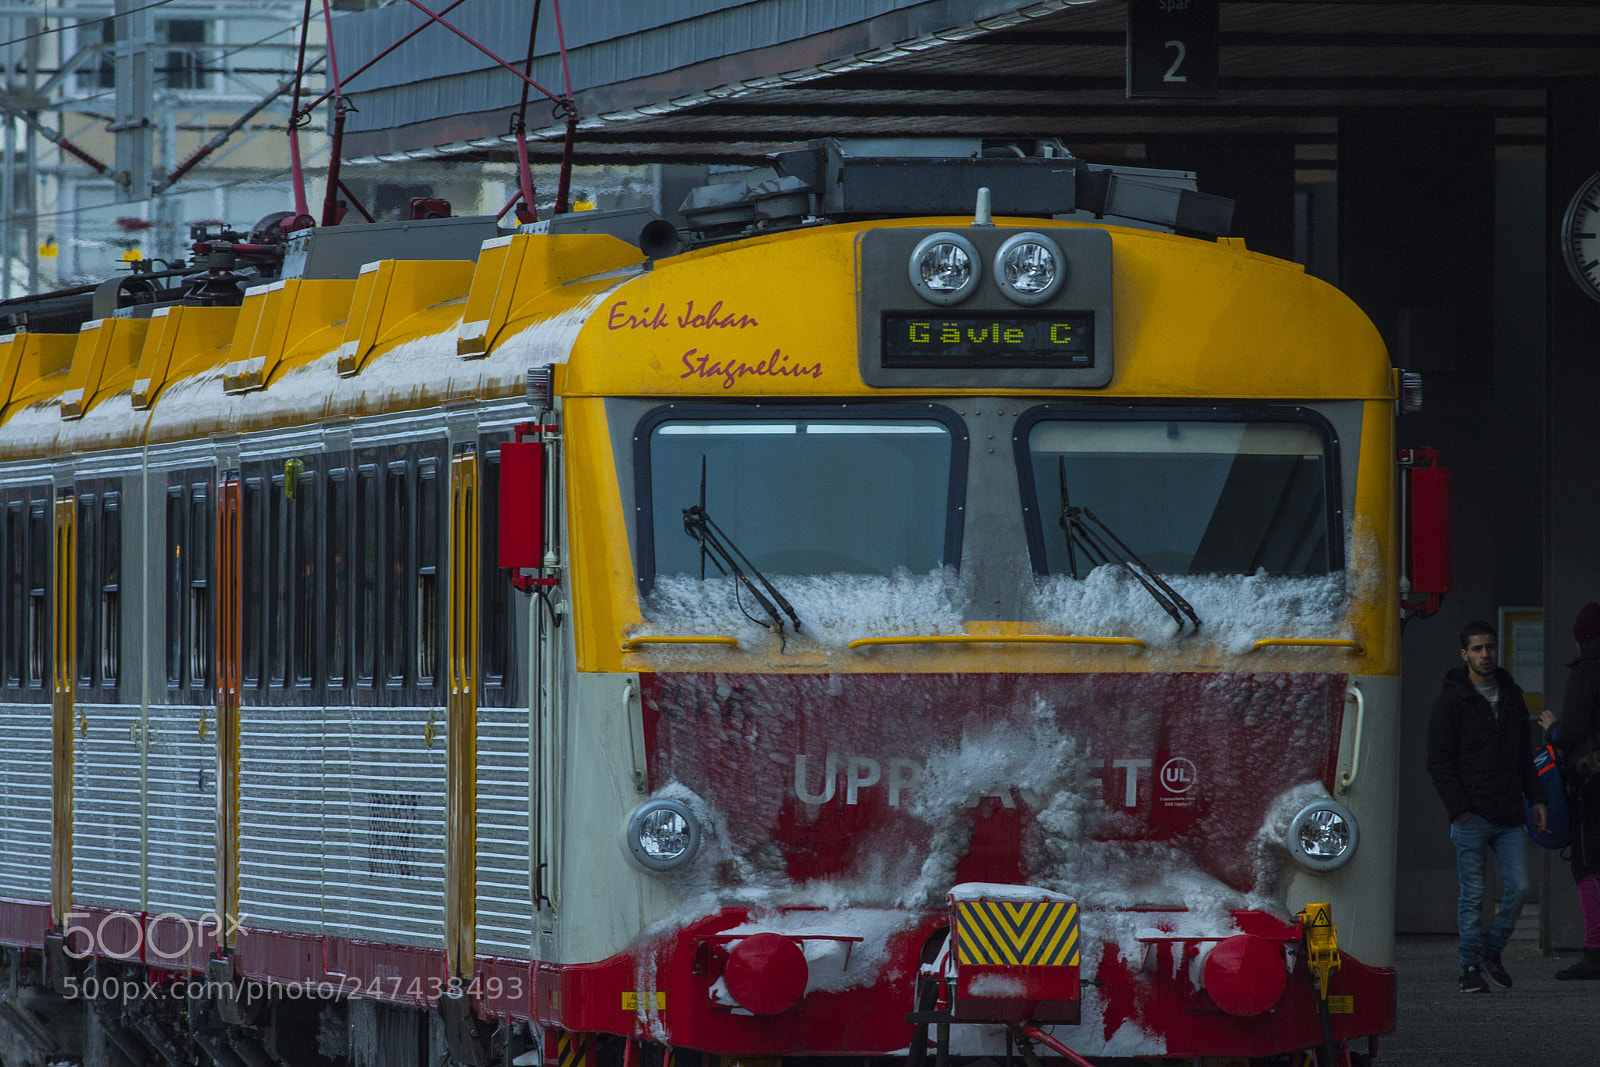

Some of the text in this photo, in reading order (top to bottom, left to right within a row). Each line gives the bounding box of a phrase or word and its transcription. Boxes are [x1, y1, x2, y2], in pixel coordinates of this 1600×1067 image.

[1163, 40, 1187, 82] 2
[608, 300, 759, 330] Erik Johan
[909, 322, 1071, 343] Gävle C
[680, 348, 823, 389] Stagnelius
[1166, 768, 1191, 782] UL
